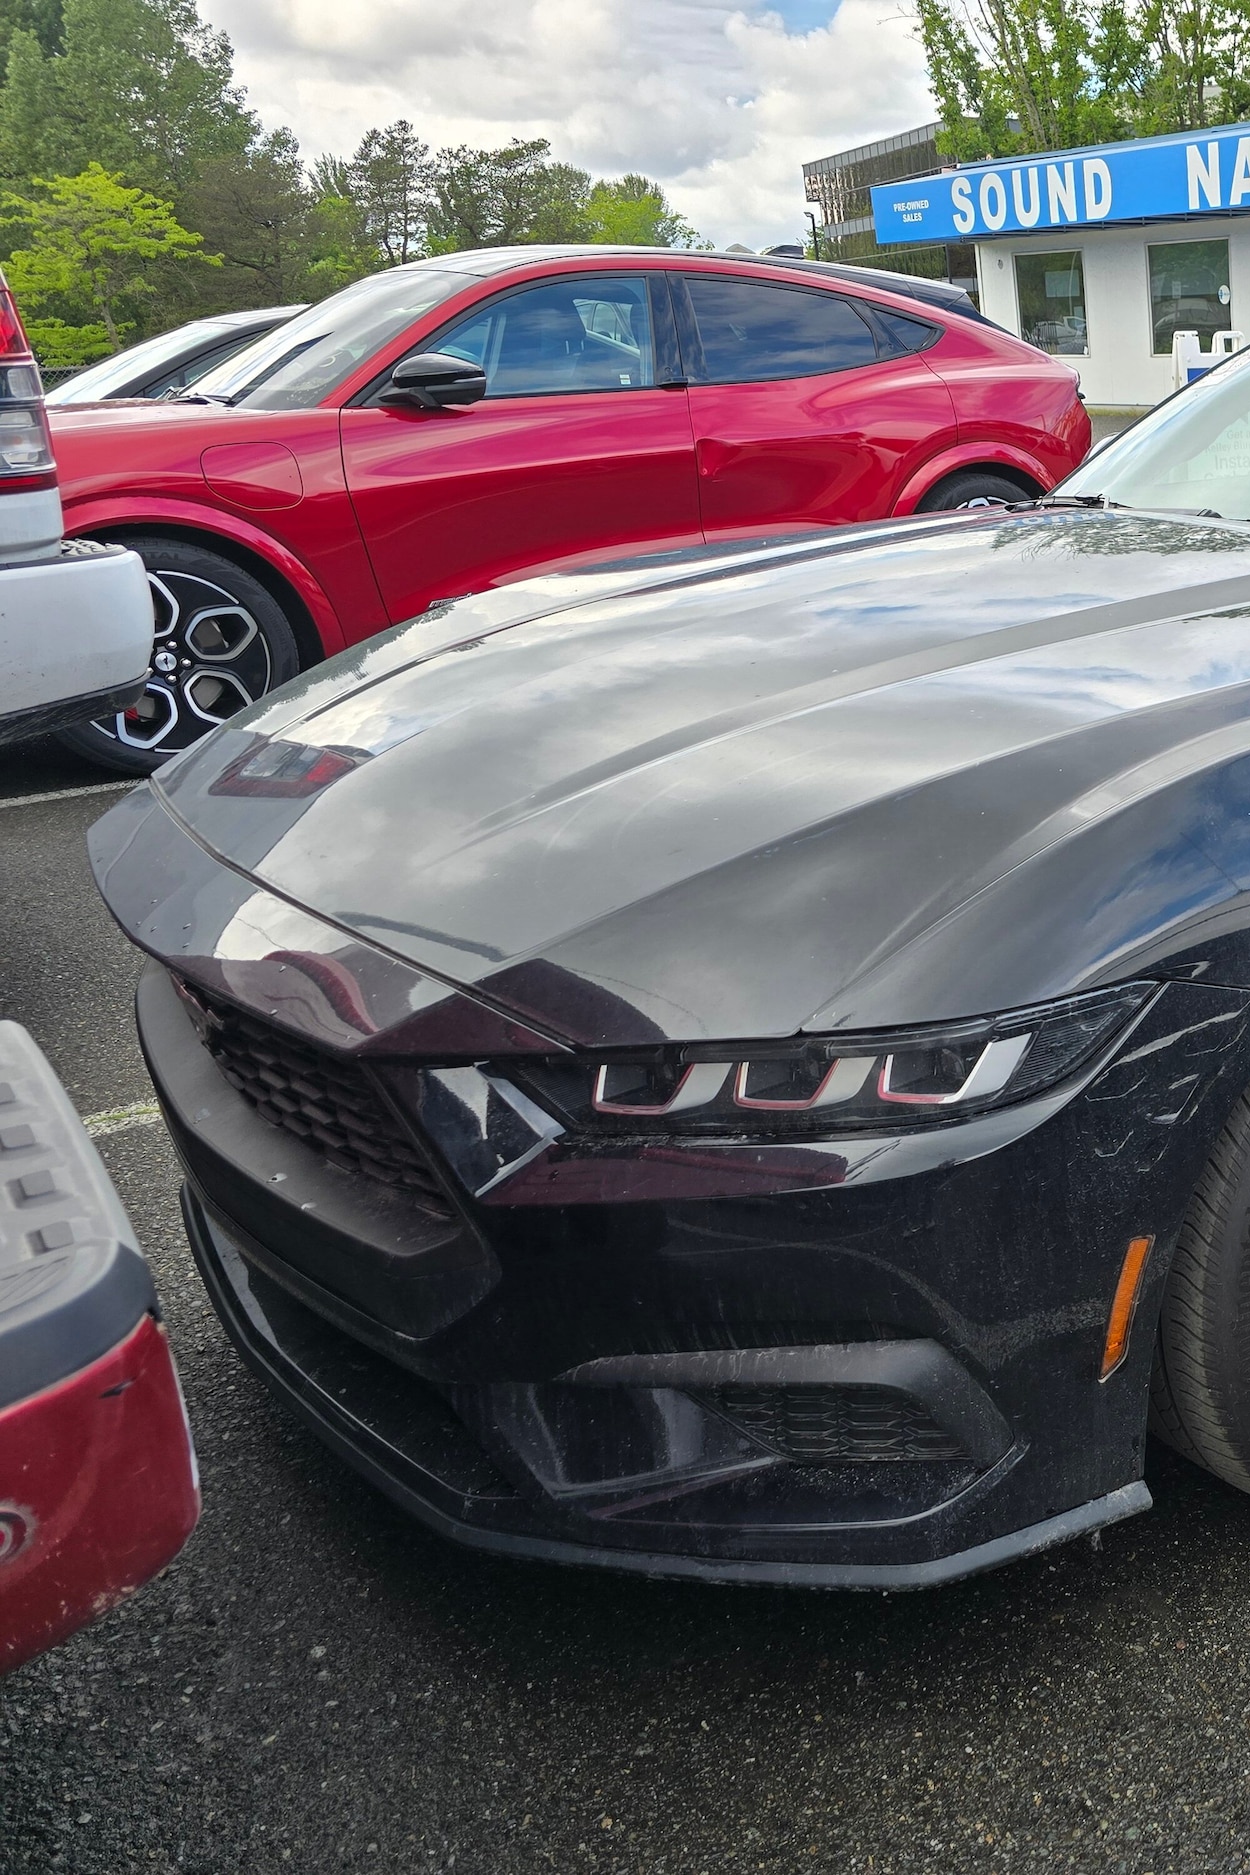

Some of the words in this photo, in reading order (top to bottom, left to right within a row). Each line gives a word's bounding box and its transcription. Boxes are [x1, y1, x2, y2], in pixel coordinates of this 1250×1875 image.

[952, 157, 1112, 235] SOUND
[893, 199, 930, 212] PRE-OWNED
[902, 212, 923, 223] SALES
